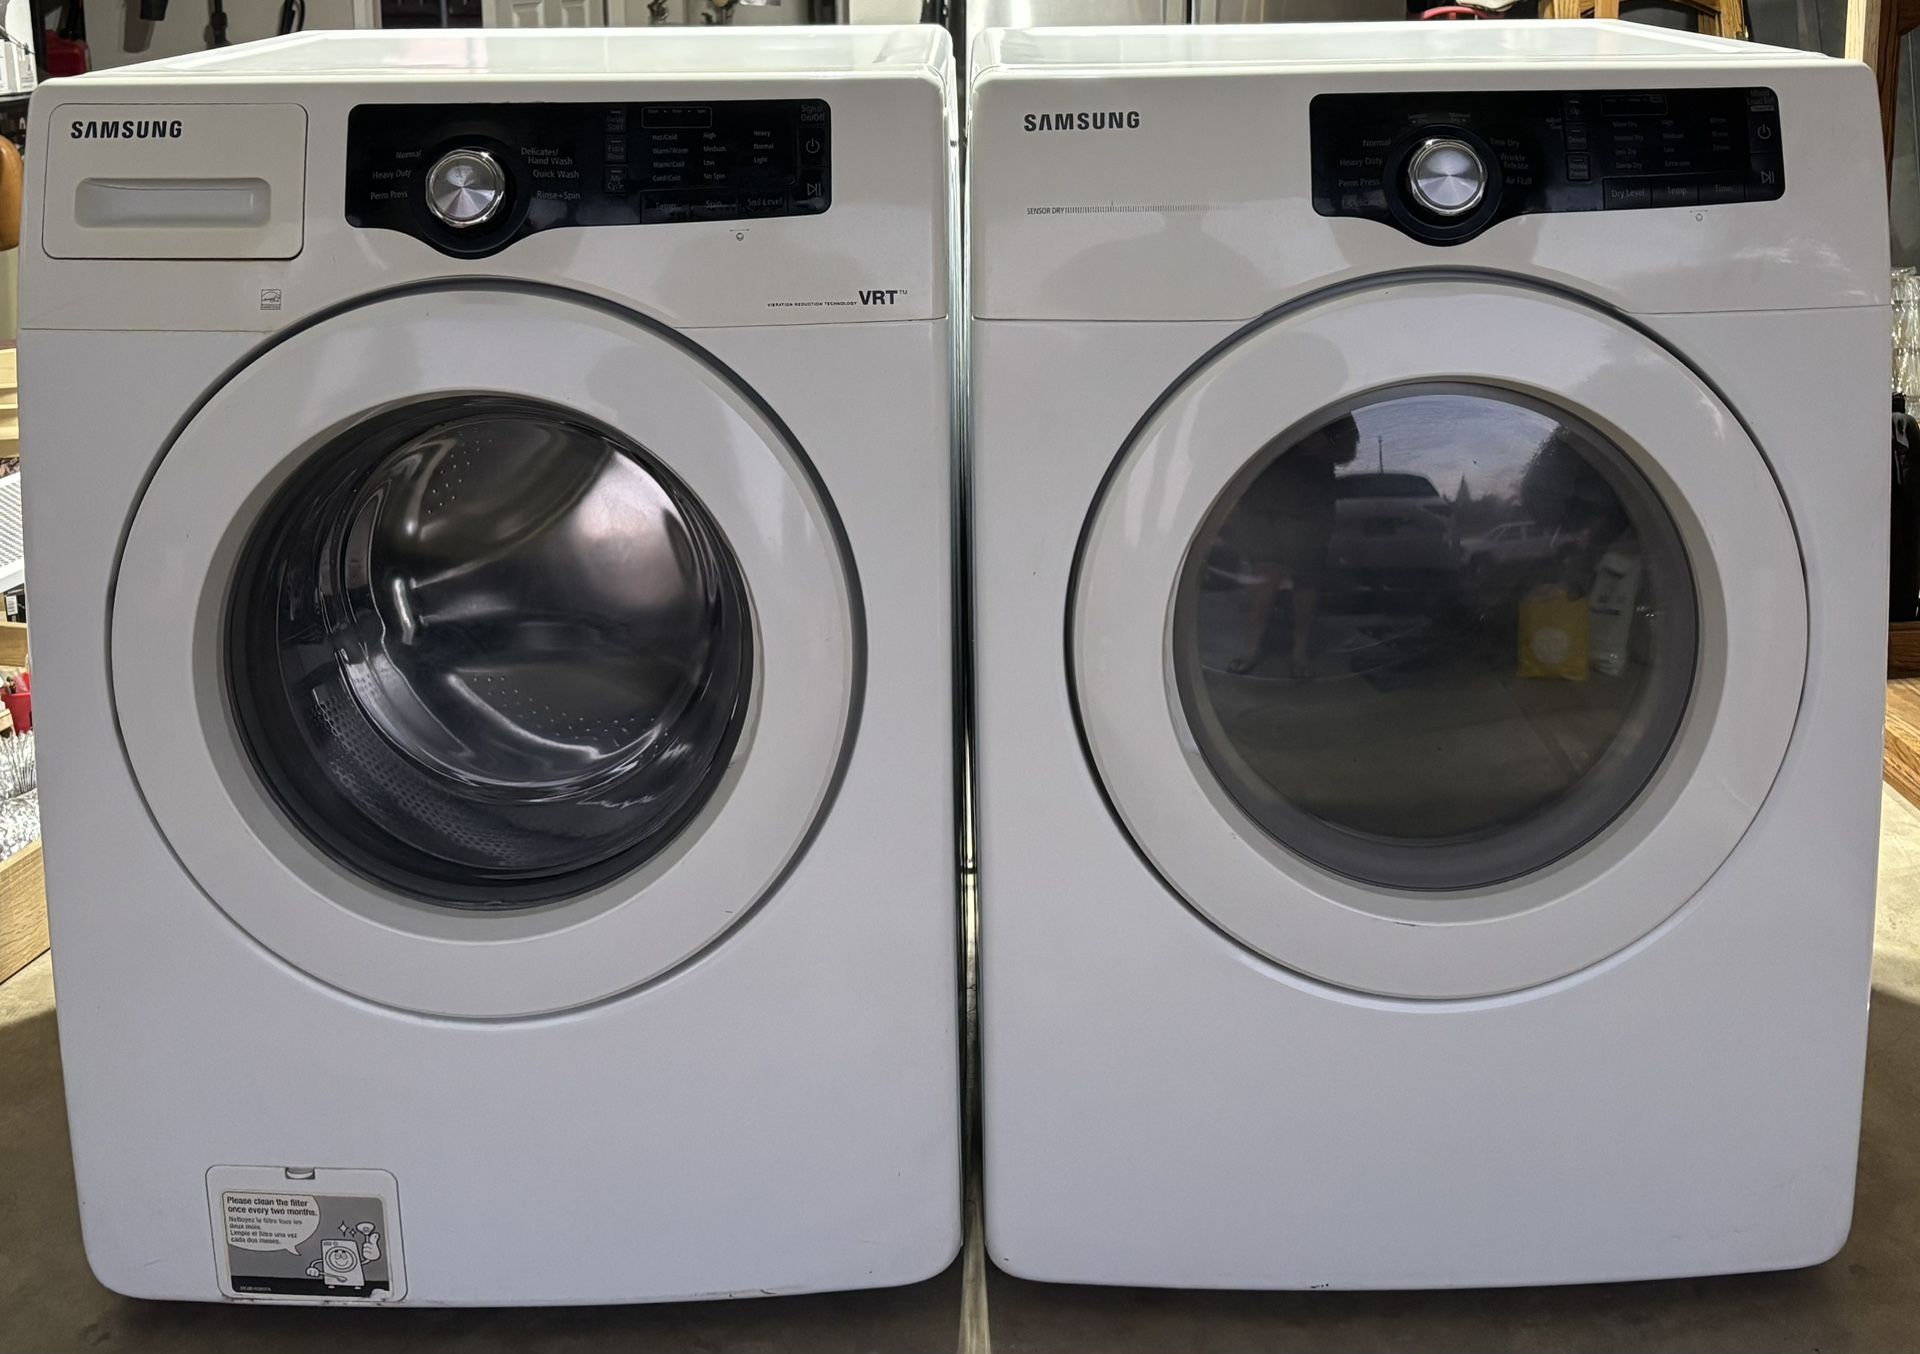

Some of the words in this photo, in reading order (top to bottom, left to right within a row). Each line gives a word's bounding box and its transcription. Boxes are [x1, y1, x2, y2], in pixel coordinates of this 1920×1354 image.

[1024, 111, 1140, 132] SAMSUNG
[71, 120, 183, 139] SAMSUNG
[1362, 138, 1391, 147] Normal
[1507, 138, 1520, 149] Dry
[396, 150, 422, 160] Normal
[521, 147, 559, 156] Delicates/
[528, 156, 549, 165] Hand
[551, 156, 573, 165] Wash
[1340, 158, 1363, 168] Heavy
[1364, 157, 1382, 167] Duty
[372, 170, 394, 180] Heavy
[395, 168, 412, 179] Duty
[533, 170, 555, 179] Quick
[557, 170, 580, 179] Wash
[1338, 179, 1359, 188] Perm
[1360, 178, 1380, 186] Press
[370, 191, 388, 200] Perm
[390, 190, 408, 199] Press
[536, 190, 581, 200] Rinse+Spin
[1611, 189, 1625, 199] Dry
[1626, 188, 1646, 198] Level
[1027, 207, 1051, 215] SENSOR
[1052, 206, 1065, 214] DRY
[227, 1196, 252, 1204] Please
[254, 1198, 274, 1206] clean
[276, 1198, 288, 1206] the
[290, 1198, 308, 1207] filter
[248, 1208, 269, 1216] every
[286, 1208, 318, 1216] months.
